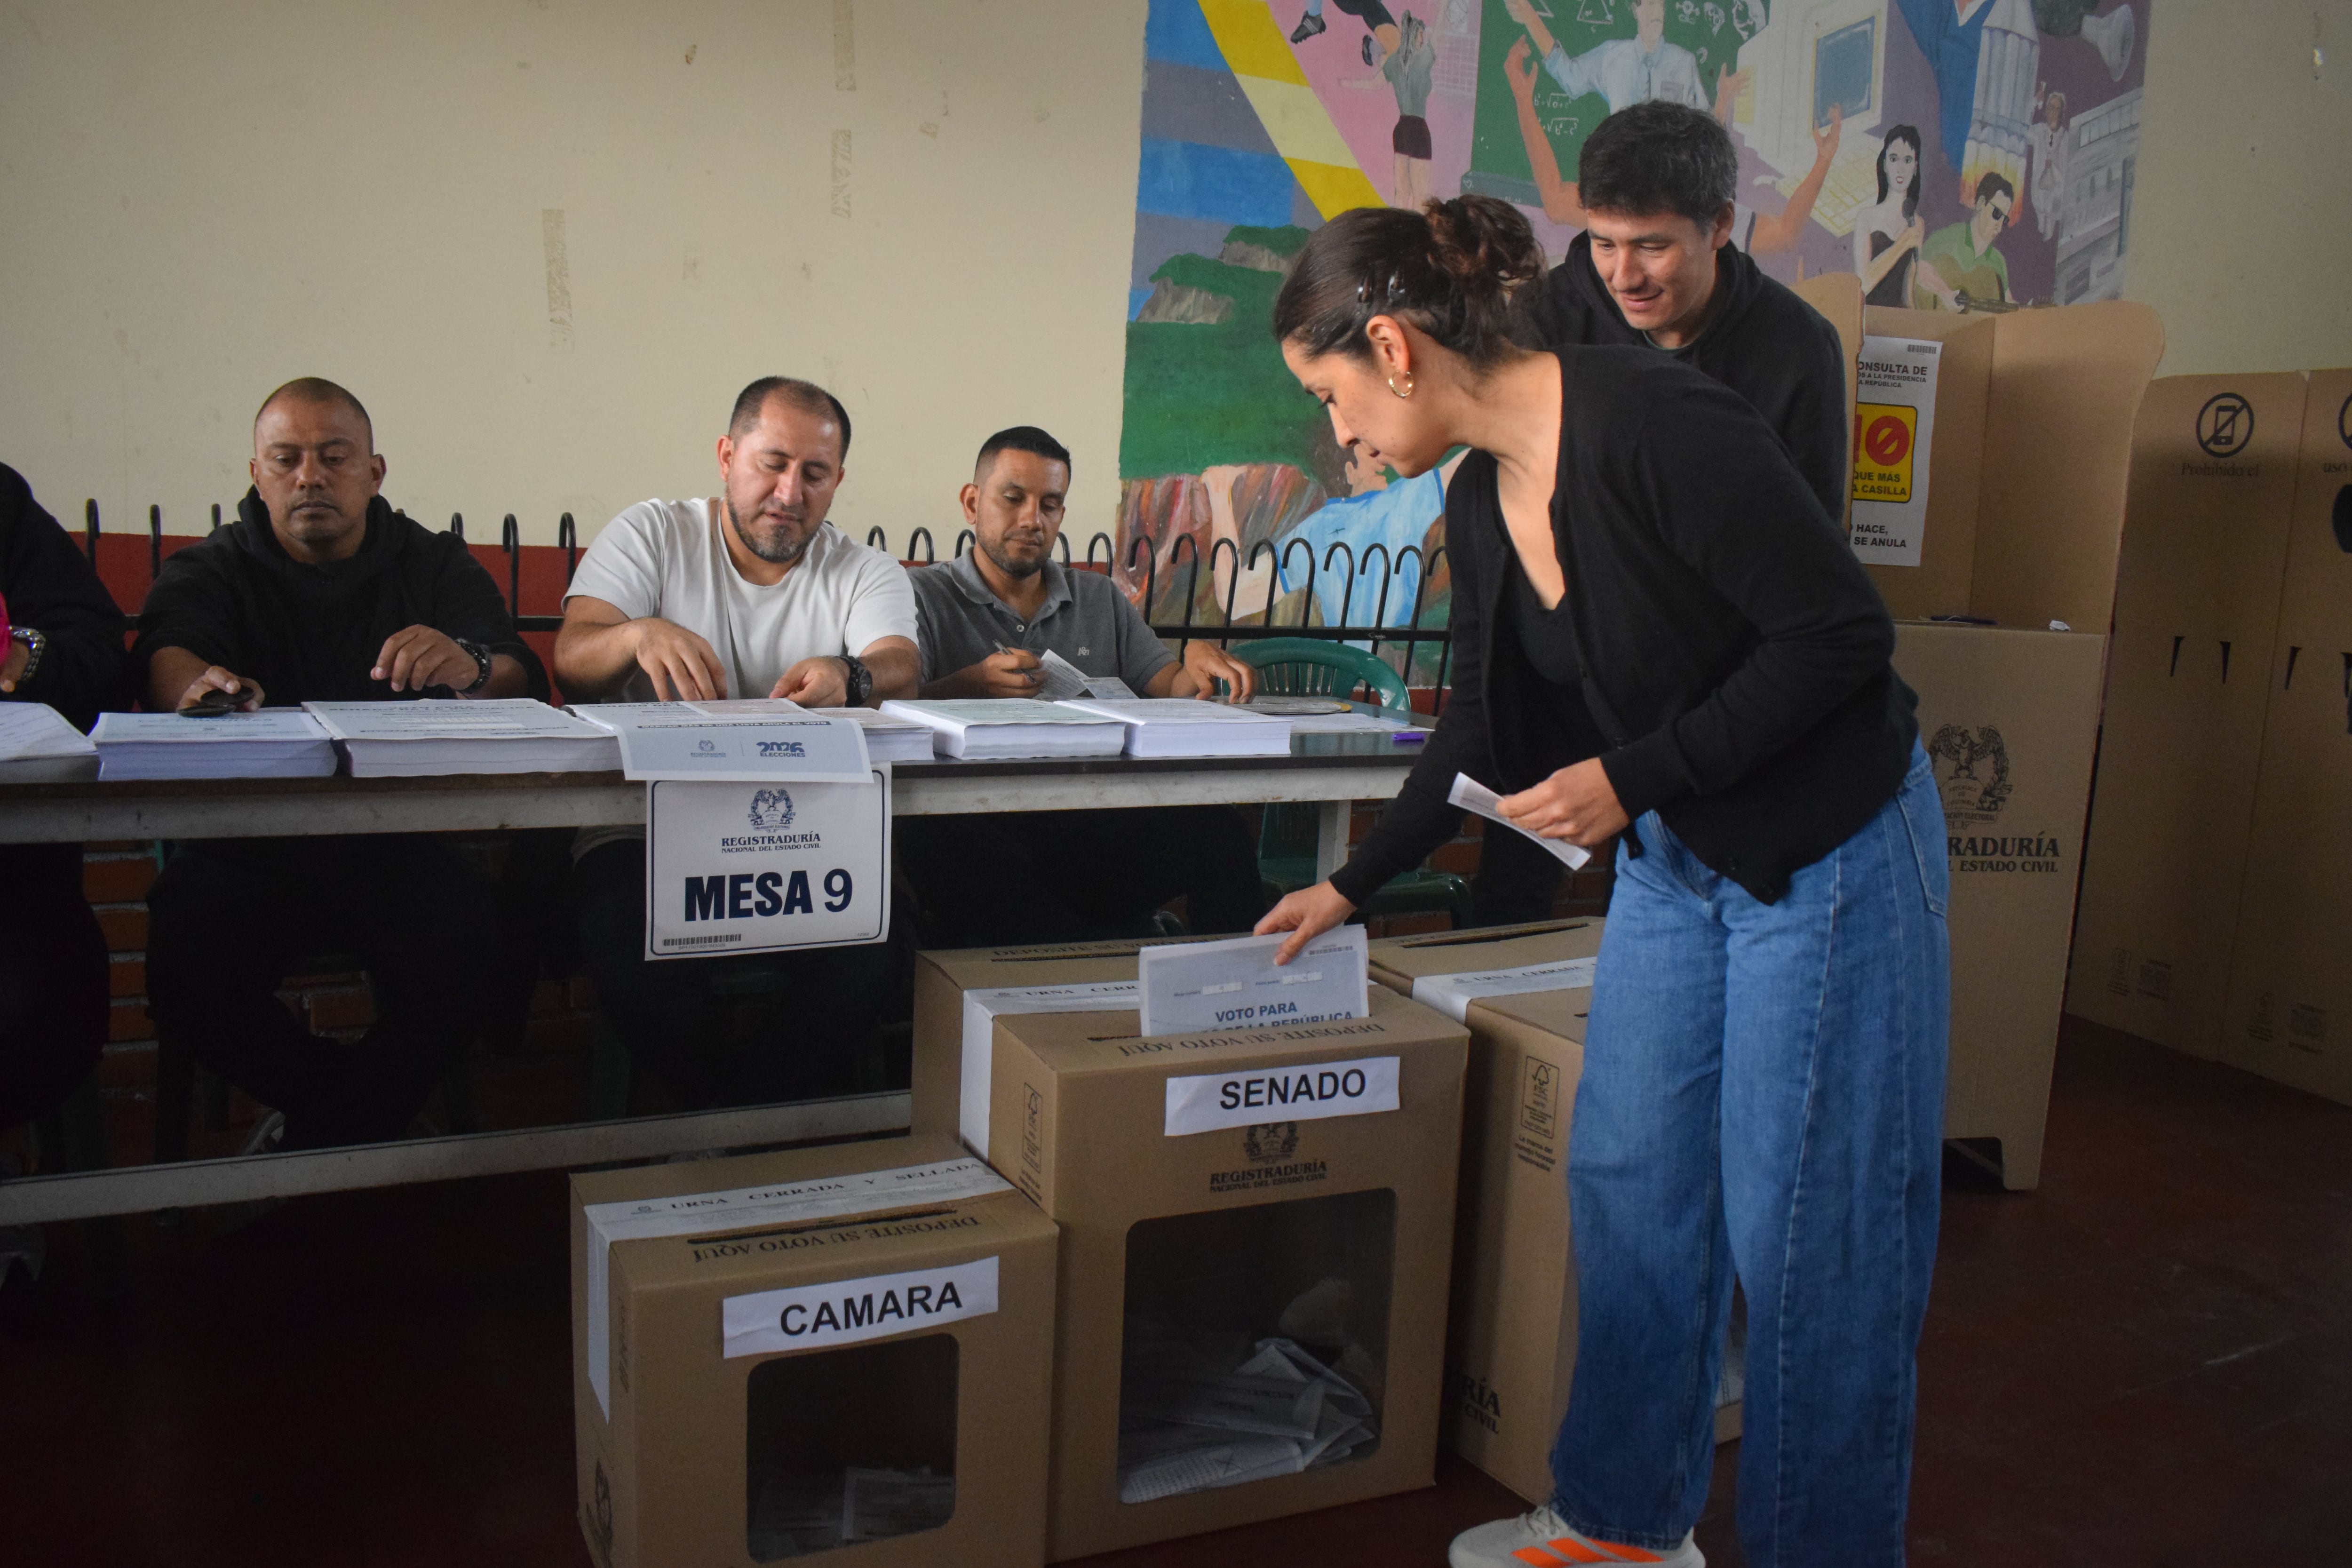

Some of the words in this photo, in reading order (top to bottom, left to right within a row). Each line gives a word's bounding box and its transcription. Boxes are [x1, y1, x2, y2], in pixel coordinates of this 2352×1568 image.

[1913, 366, 1928, 375] DE
[1865, 379, 1902, 388] REPÚBLICA
[1862, 485, 1907, 496] CASILLA
[1856, 524, 1888, 535] HACE,
[1854, 536, 1868, 545] SE
[1870, 538, 1907, 548] ANULA
[721, 831, 821, 846] REGISTRADURÍA
[1960, 860, 2017, 872] ESTADO
[2021, 861, 2058, 873] CIVIL
[685, 870, 813, 922] MESA
[823, 868, 853, 912] 9
[1522, 965, 1583, 977] CERRADA
[1215, 1008, 1255, 1022] VOTO
[1259, 1002, 1297, 1016] PARA
[1245, 1035, 1276, 1043] SU
[1277, 1024, 1387, 1041] DEPOSITE
[1180, 1038, 1243, 1050] VOTO
[1219, 1068, 1367, 1110] SENADO
[1210, 1159, 1327, 1185] REGISTRADURÍA
[670, 1197, 728, 1210] URNA
[748, 1183, 844, 1200] CERRADA
[895, 1163, 980, 1182] SELLADA
[1210, 1182, 1252, 1193] NACIONAL
[1273, 1177, 1303, 1186] ESTADO
[1305, 1173, 1327, 1182] CIVIL
[865, 1217, 981, 1239] DEPOSITE
[759, 1235, 825, 1252] VOTO
[831, 1230, 861, 1243] SU
[780, 1281, 962, 1337] CAMARA
